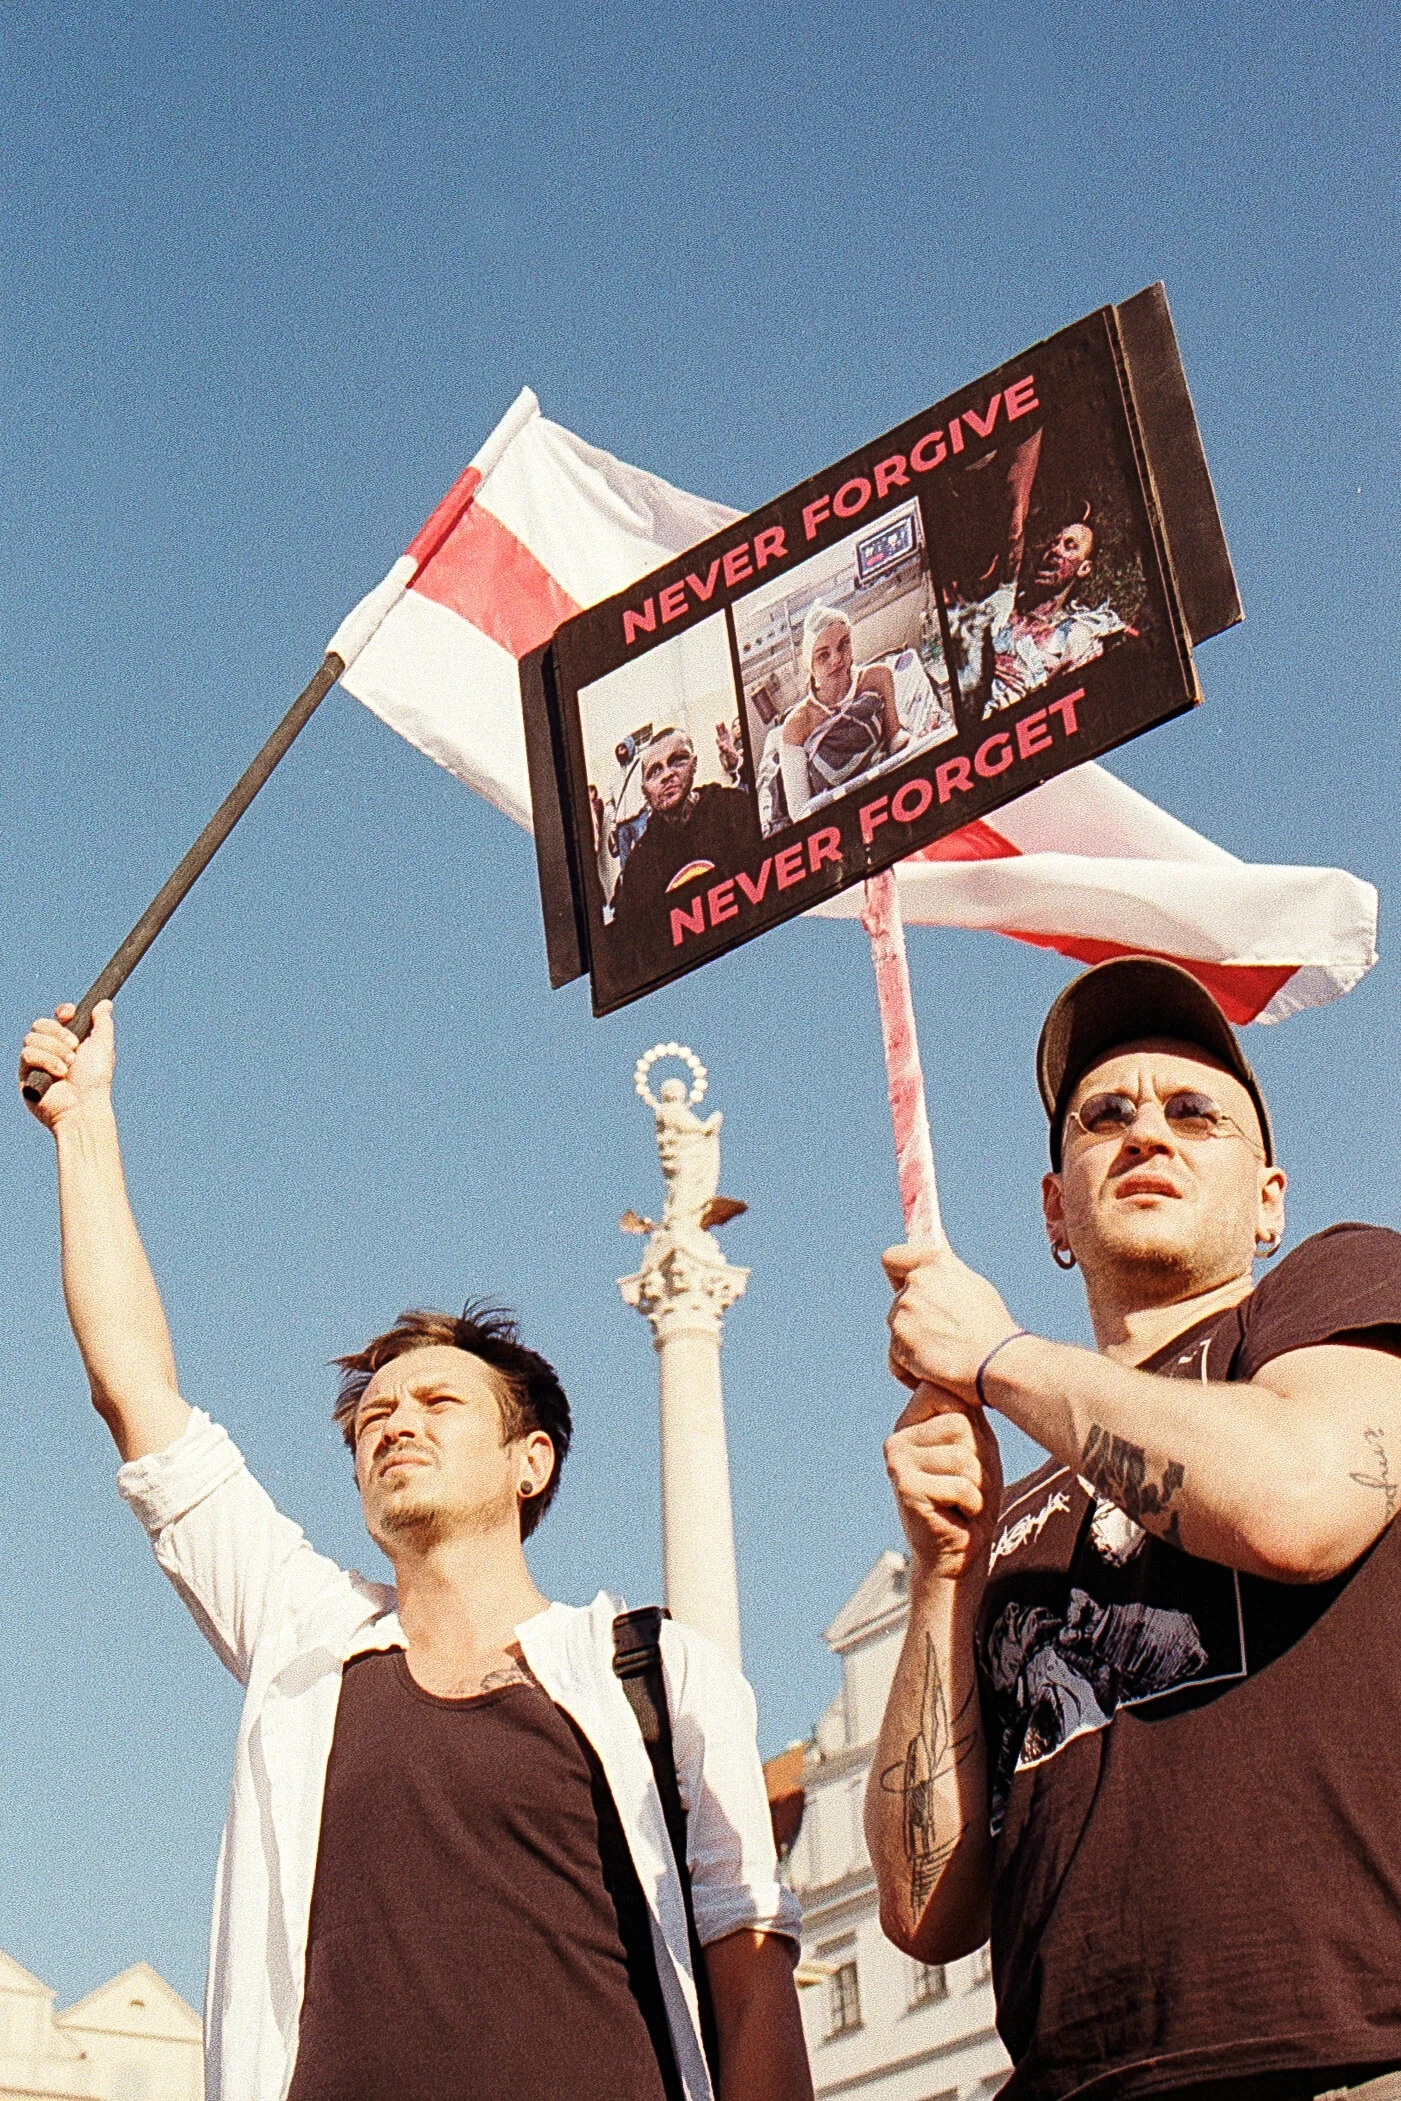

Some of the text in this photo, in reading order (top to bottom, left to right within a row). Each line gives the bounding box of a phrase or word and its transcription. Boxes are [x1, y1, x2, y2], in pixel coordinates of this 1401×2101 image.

[622, 375, 1040, 645] NEVER FORGIVE
[669, 687, 1086, 947] NEVER FORGET
